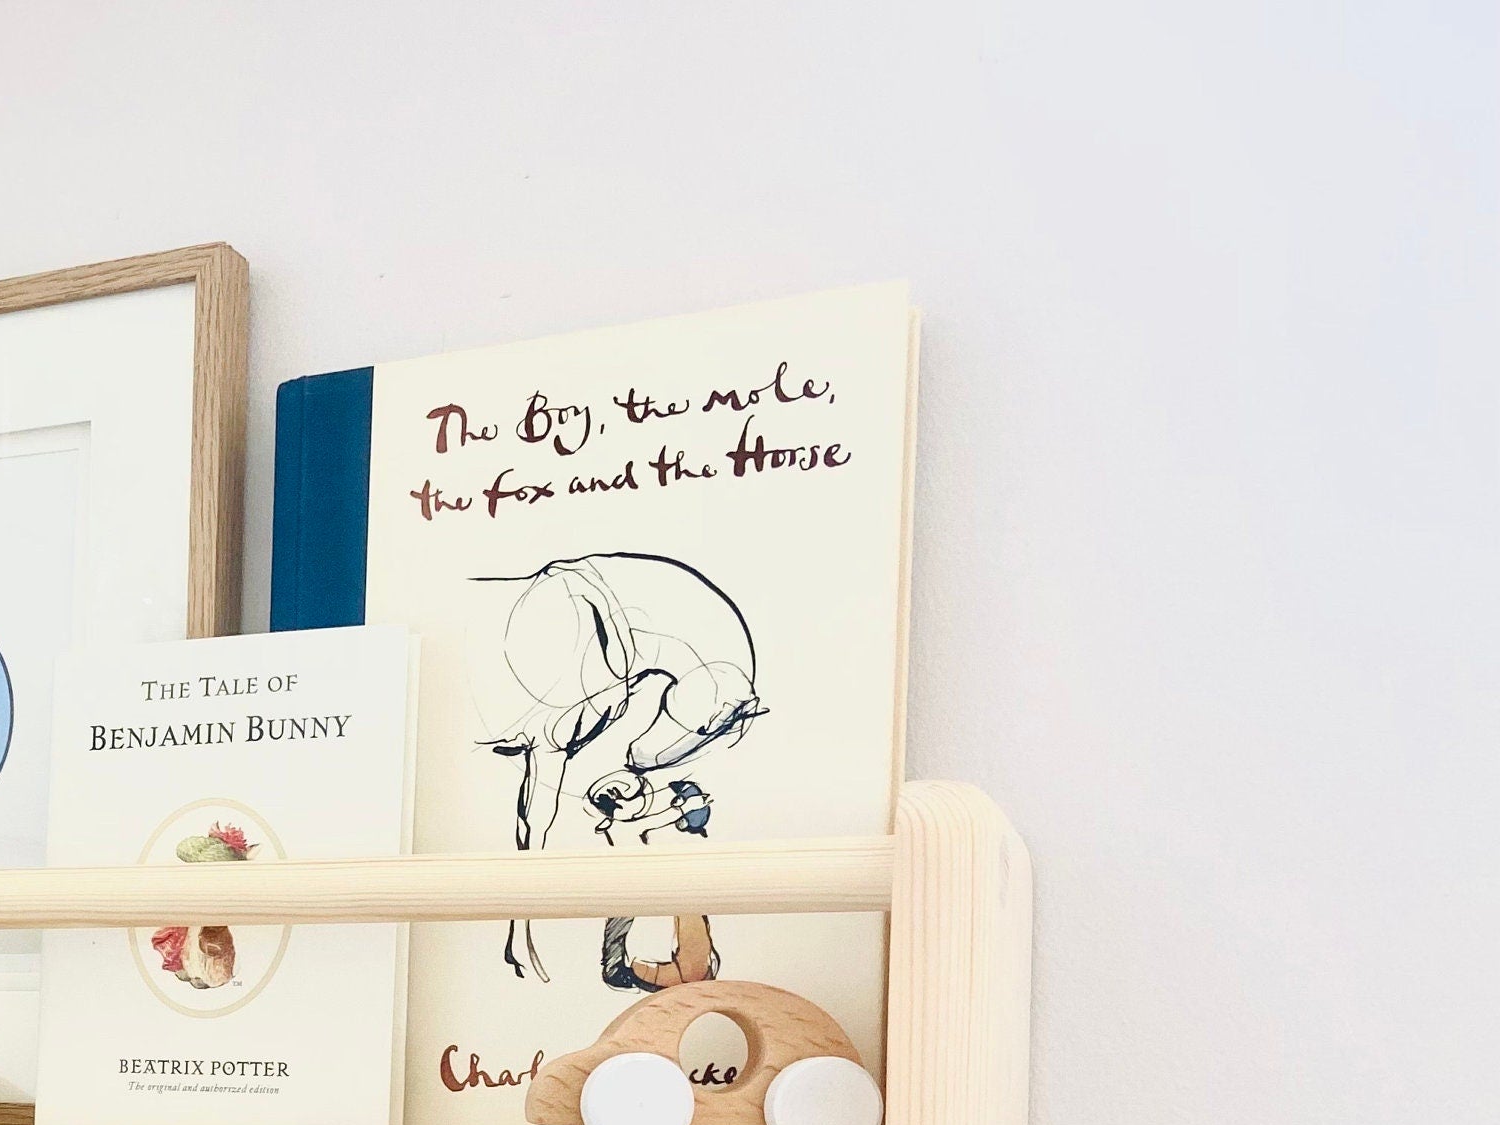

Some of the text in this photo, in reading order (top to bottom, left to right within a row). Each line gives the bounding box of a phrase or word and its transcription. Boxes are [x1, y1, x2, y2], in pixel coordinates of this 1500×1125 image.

[426, 403, 499, 454] The
[515, 390, 605, 457] Boy,
[612, 387, 690, 424] the
[409, 479, 473, 521] the
[568, 460, 639, 495] and
[648, 444, 718, 487] the
[726, 414, 852, 478] Horse
[89, 714, 352, 752] BENJAMIN BUNNY
[119, 1058, 290, 1077] BEATRIX POTTER
[128, 1081, 145, 1091] The
[147, 1083, 181, 1095] original
[181, 1083, 199, 1092] and
[248, 1084, 280, 1095] edition
